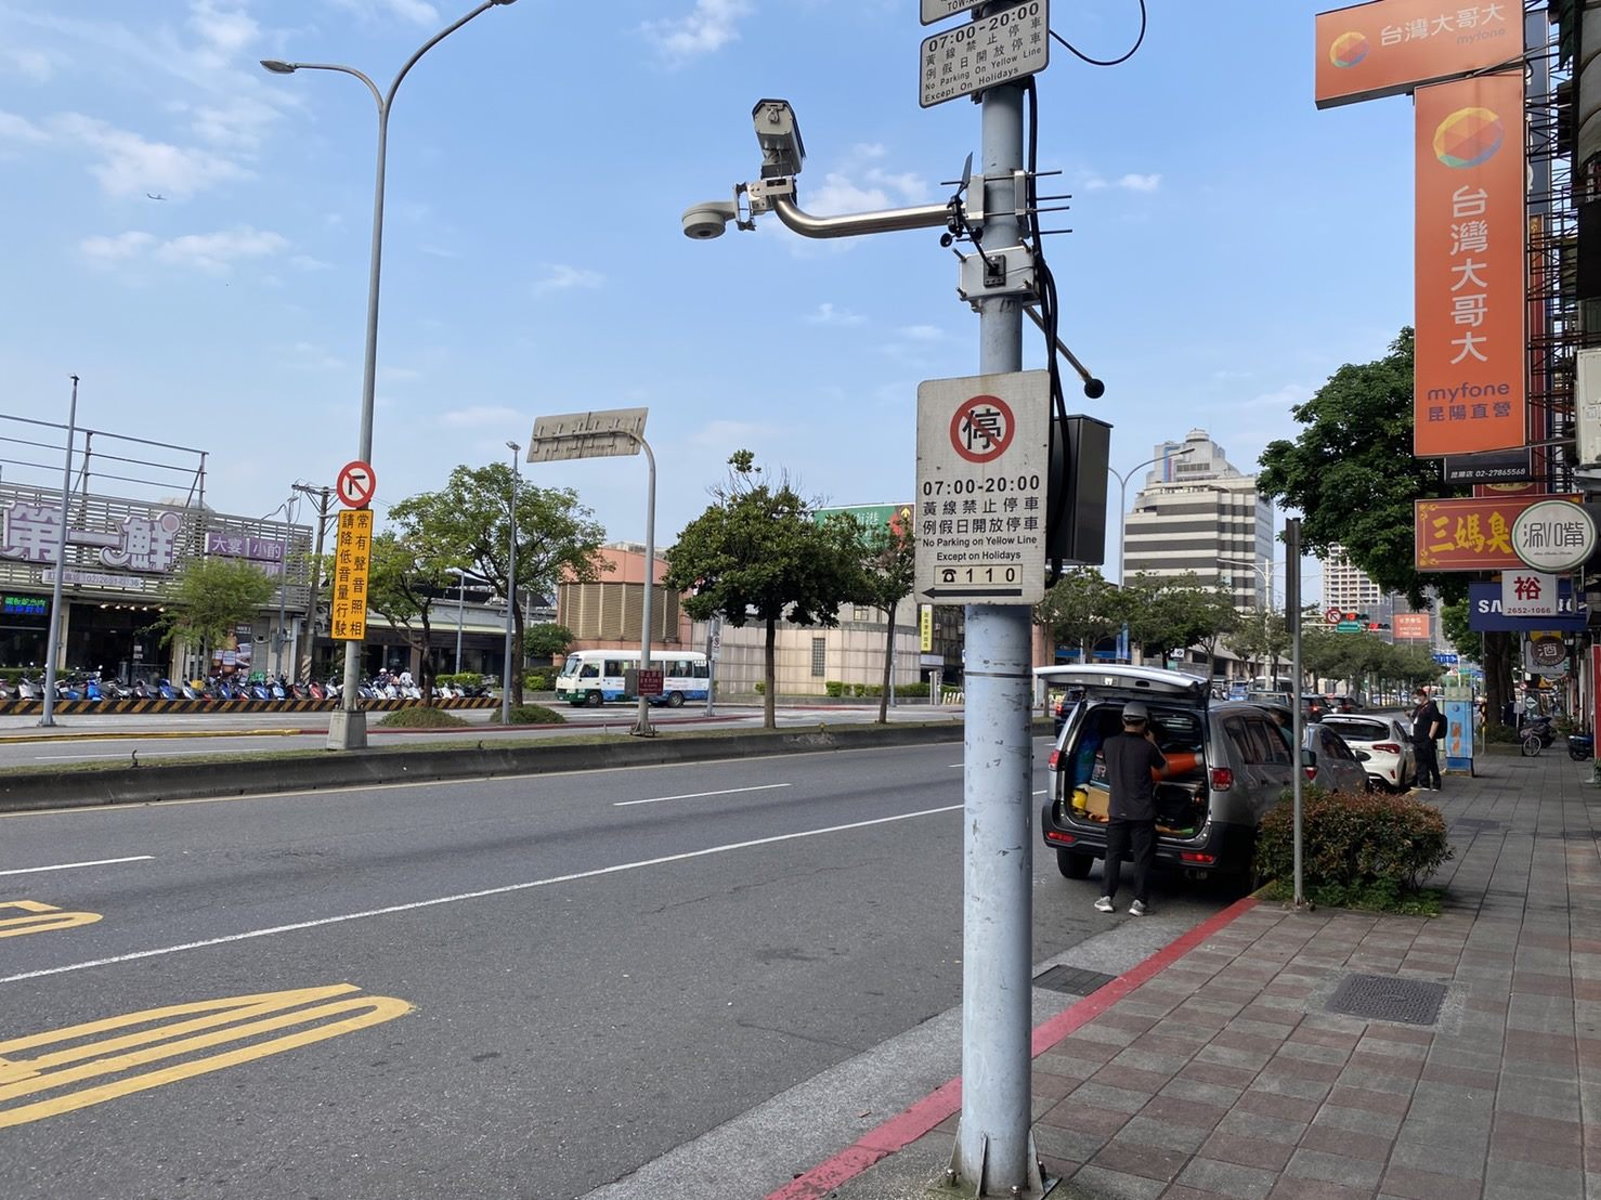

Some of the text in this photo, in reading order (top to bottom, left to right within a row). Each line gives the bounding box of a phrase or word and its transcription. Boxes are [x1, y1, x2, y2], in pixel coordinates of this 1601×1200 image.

[947, 0, 978, 11] TOW-A
[928, 3, 1039, 52] 07:00-20:00
[1380, 2, 1505, 46] 台灣大哥大
[925, 17, 1041, 67] 黃線禁止停車
[926, 32, 1041, 80] 例假日開放停車
[925, 47, 1042, 91] No Parking On Yellow Line
[925, 67, 1019, 103] Except On Holidays
[1450, 185, 1489, 365] 台灣大哥大
[1427, 381, 1510, 403] myfone
[1427, 401, 1511, 423] 昆陽直營
[923, 475, 1040, 495] 07:00-20:00
[922, 496, 1039, 516] 黃線禁止停車
[922, 516, 1039, 535] 例假日開放停車
[922, 535, 1037, 548] No Parking on Yellow Line
[937, 551, 1021, 562] Except on Holidays
[335, 513, 354, 637] 請降低音量行駛
[350, 513, 369, 637] 常有聲音照相
[966, 567, 1016, 583] 110
[1513, 576, 1542, 601] 裕
